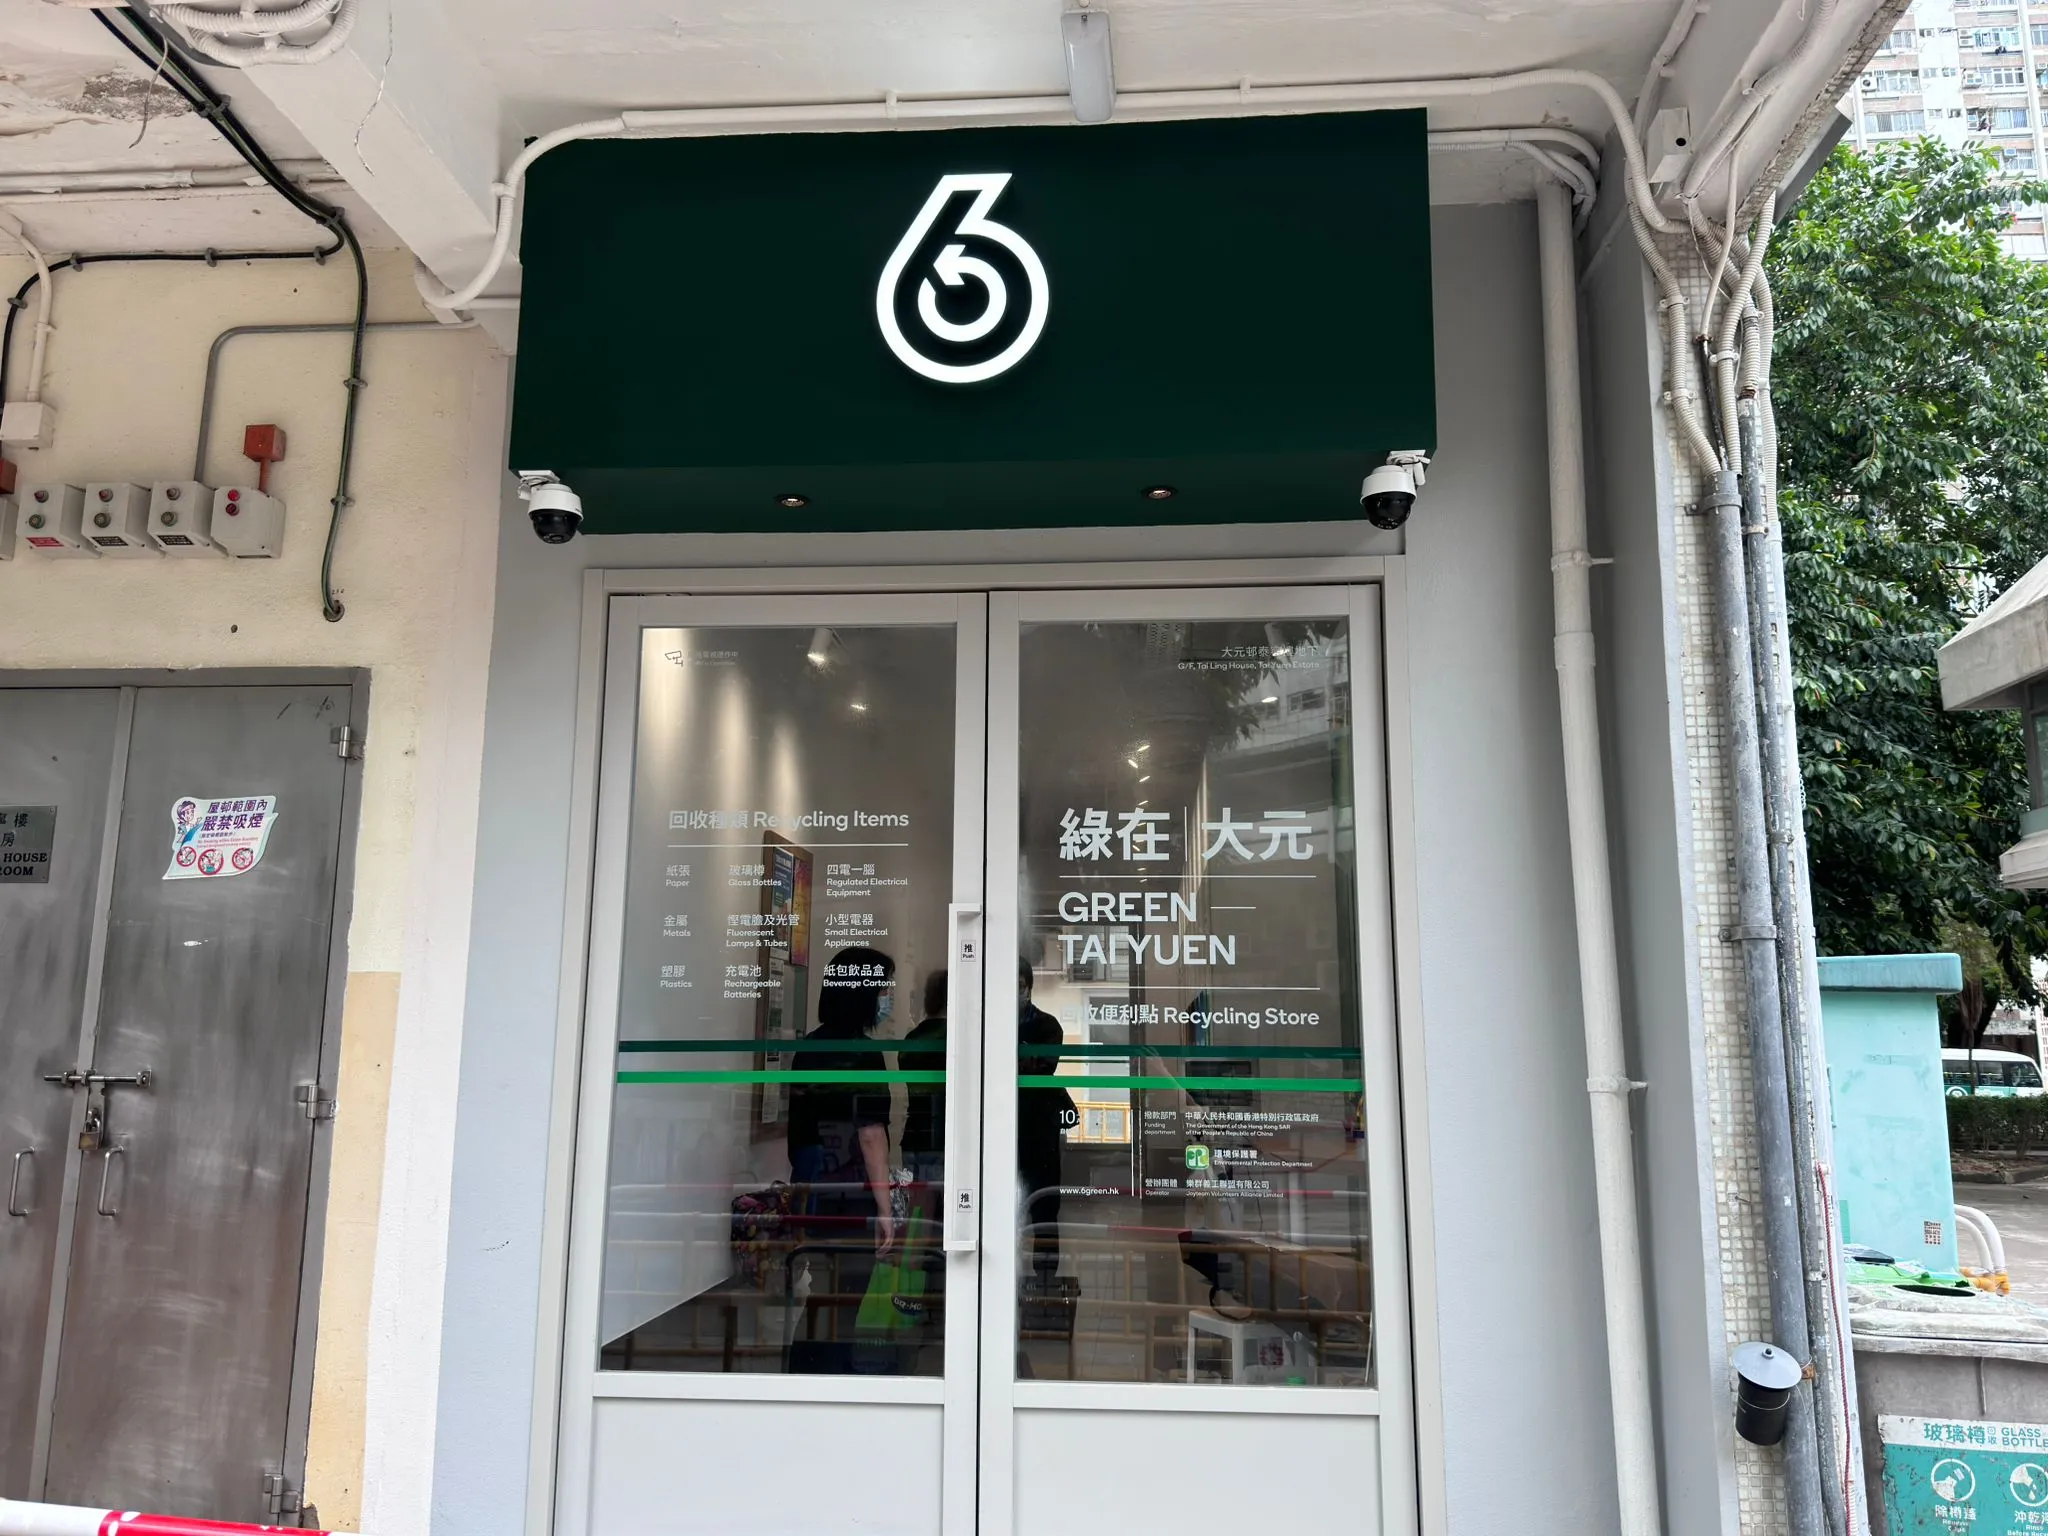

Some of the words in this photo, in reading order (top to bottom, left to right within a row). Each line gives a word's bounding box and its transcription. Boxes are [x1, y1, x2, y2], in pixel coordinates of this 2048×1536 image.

[208, 799, 268, 814] 屋邨範圍內
[201, 813, 264, 832] 嚴禁吸煙
[753, 811, 849, 832] Reycling
[853, 810, 909, 828] Items
[1059, 807, 1170, 861] 綠在
[1201, 807, 1314, 861] 大元
[3, 852, 48, 863] HOUSE
[665, 864, 691, 877] 紙張
[728, 864, 765, 877] 玻璃樽
[827, 864, 875, 876] 四電一腦
[665, 879, 690, 888] Paper
[826, 878, 869, 888] Regulated
[870, 877, 908, 886] Electrical
[826, 889, 871, 898] Equipment
[1058, 892, 1197, 922] GREEN
[664, 915, 688, 928] 金屬
[825, 914, 874, 926] 小型電器
[663, 929, 691, 938] Metals
[726, 928, 774, 937] Fluorescent
[825, 928, 849, 936] Small
[850, 928, 888, 936] Electrical
[726, 940, 754, 948] Lamps
[824, 939, 870, 948] Appliances
[661, 965, 686, 978] 塑膠
[725, 965, 762, 977] 充電池
[823, 964, 885, 977] 紙包飲品盒
[660, 980, 692, 989] Plastics
[724, 980, 781, 990] Rechargeable
[823, 979, 861, 988] Beverage
[863, 979, 896, 987] Cartons
[723, 991, 762, 999] Batteries
[1164, 1007, 1261, 1028] Recycling
[1265, 1008, 1320, 1025] Store
[1185, 1111, 1319, 1122] 中華人民共和國香港特別行政區政府
[1197, 1122, 1230, 1130] Government
[1248, 1123, 1263, 1131] Hong
[1263, 1123, 1278, 1131] Kong
[1281, 1160, 1313, 1168] Department
[1059, 1187, 1119, 1196] www.6green.hk
[1923, 1422, 1986, 1445] 玻璃樽
[2001, 1427, 2041, 1438] GLASS
